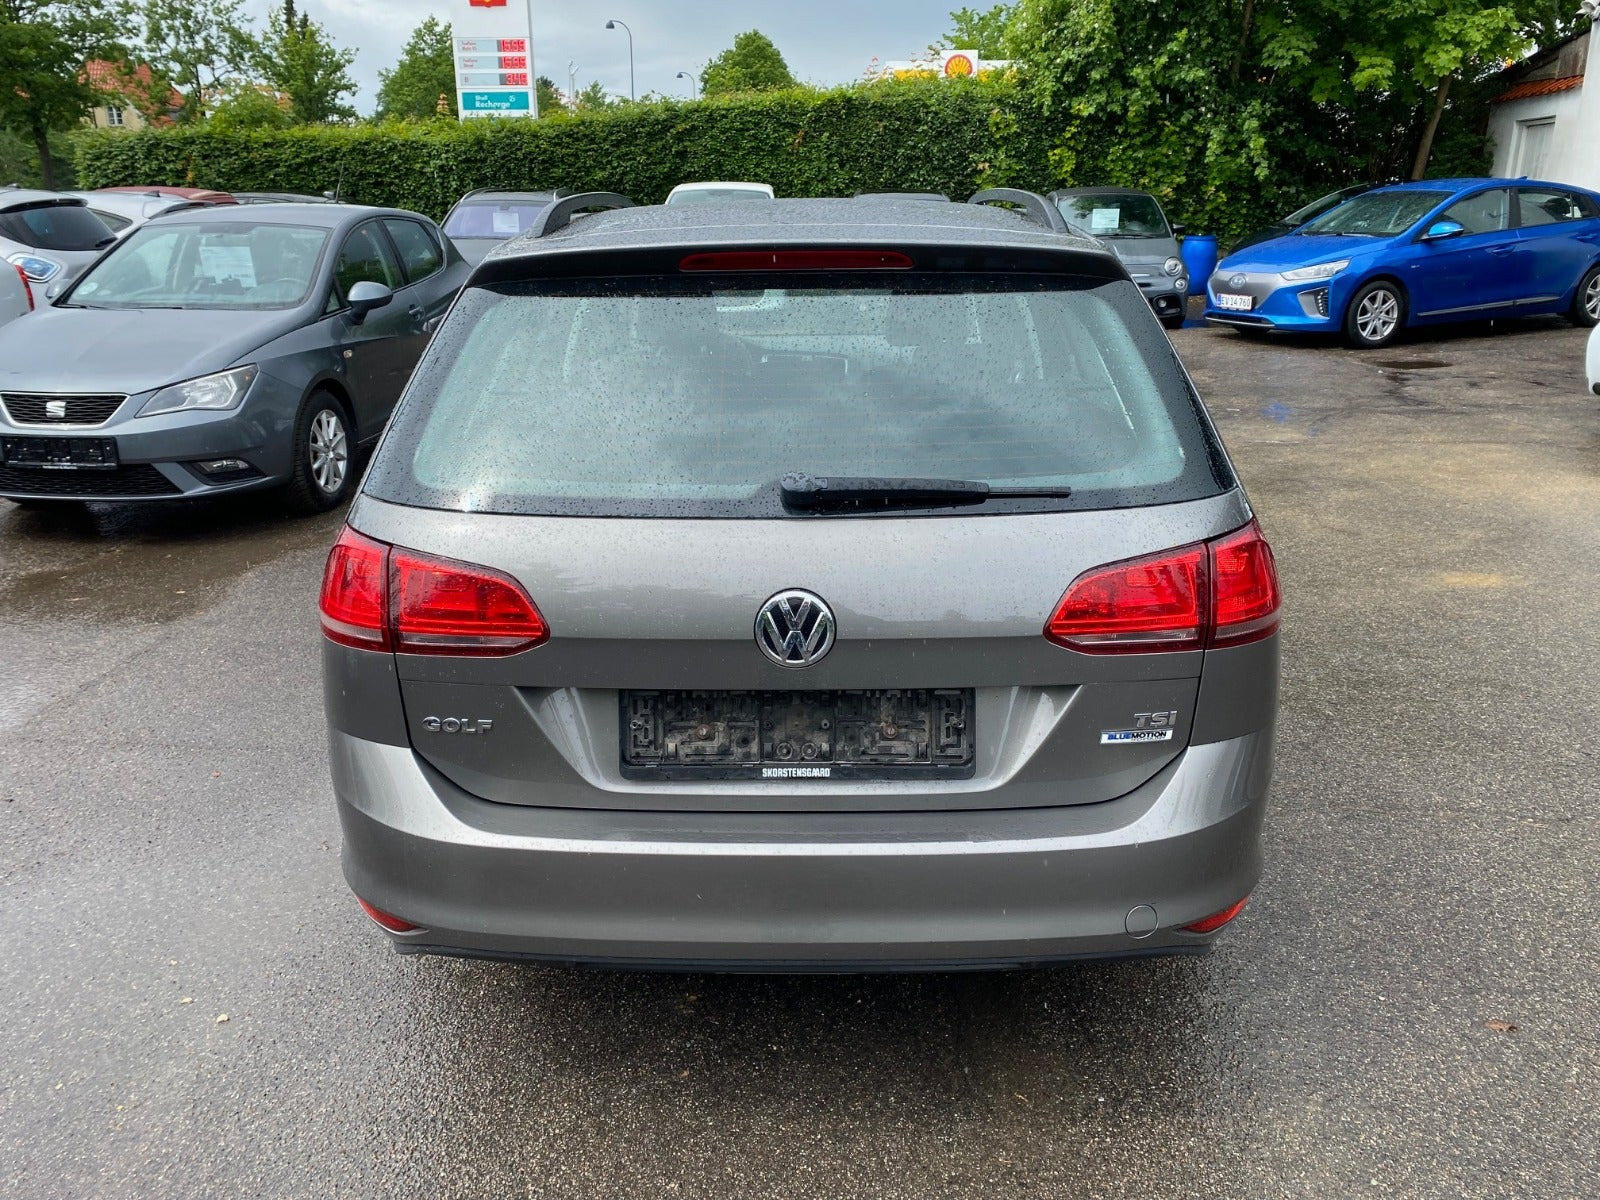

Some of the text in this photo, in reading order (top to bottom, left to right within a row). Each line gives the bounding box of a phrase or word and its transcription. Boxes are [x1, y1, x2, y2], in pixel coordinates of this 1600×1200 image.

[475, 101, 511, 109] Recharge
[1133, 711, 1177, 727] TSI
[422, 716, 493, 734] GOLF
[1107, 731, 1166, 741] BLUEMOTION
[762, 767, 831, 777] SKORSTENSGAARD
